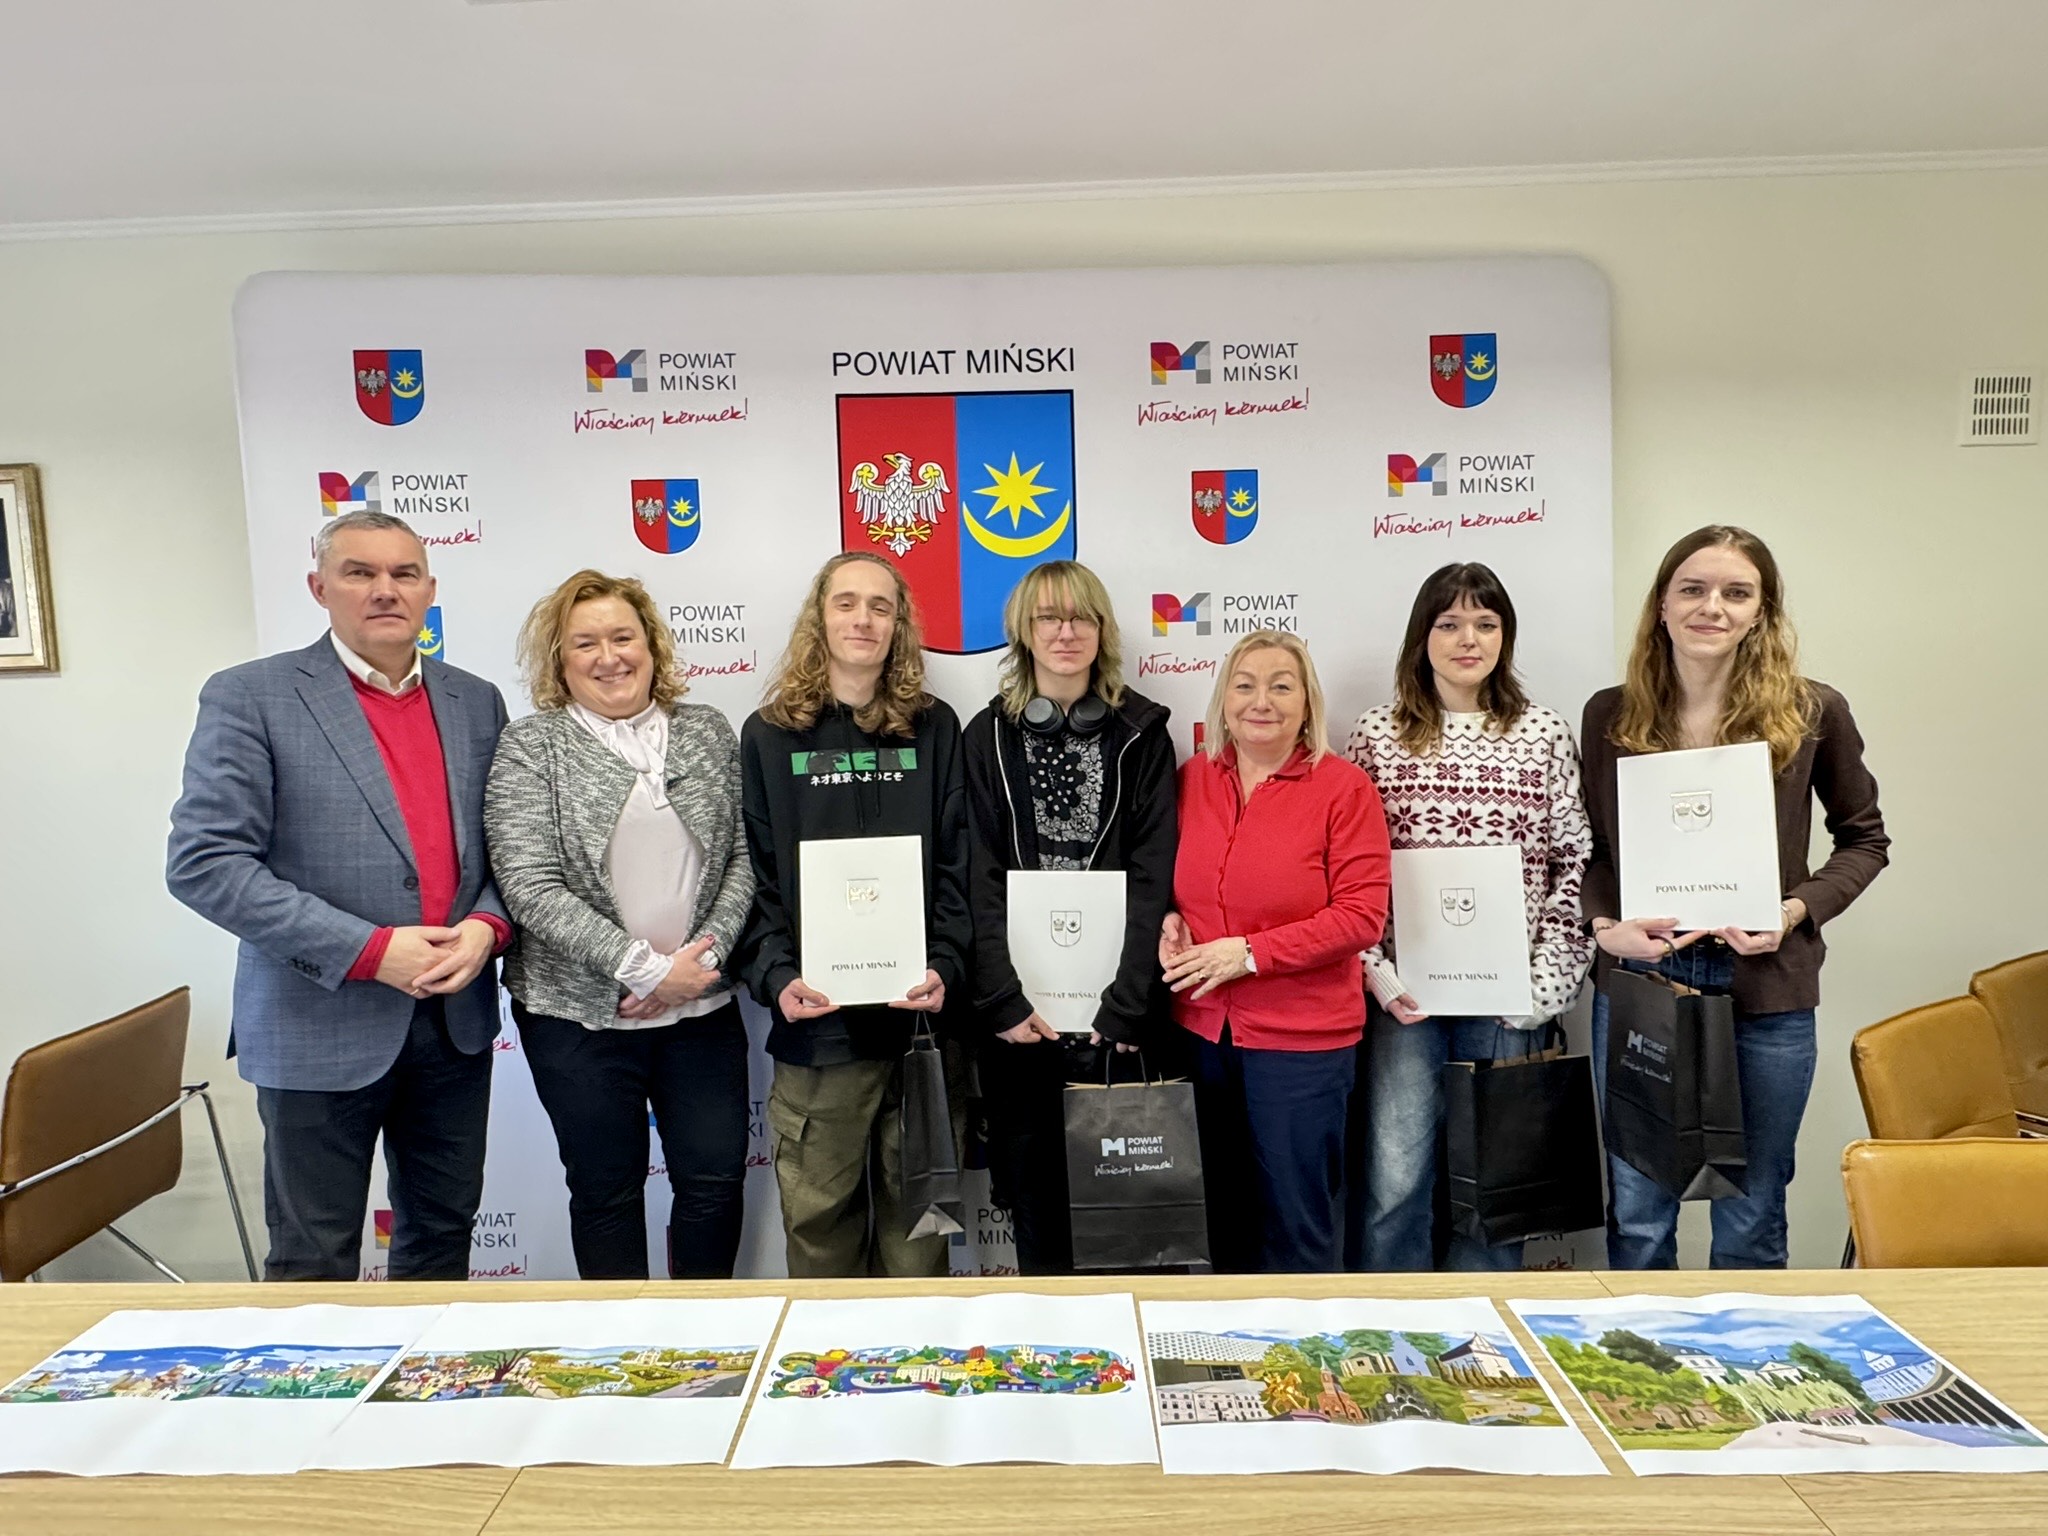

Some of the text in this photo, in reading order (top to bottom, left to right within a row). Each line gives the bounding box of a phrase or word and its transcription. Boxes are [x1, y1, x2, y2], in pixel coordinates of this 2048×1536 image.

[833, 343, 1075, 377] POWIAT MIŃSKI
[1223, 343, 1299, 360] POWIAT
[659, 353, 737, 369] POWIAT
[1223, 362, 1299, 382] MIŃSKI
[660, 372, 737, 391] MIŃSKI
[1459, 454, 1535, 472] POWIAT
[392, 474, 468, 491] POWIAT
[1459, 474, 1535, 494] MIŃSKI
[394, 494, 470, 513] MIŃSKI
[1223, 594, 1298, 611] POWIAT
[670, 605, 745, 622] POWIAT
[1223, 614, 1298, 633] MIŃSKI
[671, 624, 745, 643] MIŃSKI
[1127, 1136, 1163, 1146] POWIAT
[1128, 1144, 1163, 1155] MIŃSKI
[473, 1213, 516, 1228] WIAT
[471, 1230, 516, 1248] ŃSKI
